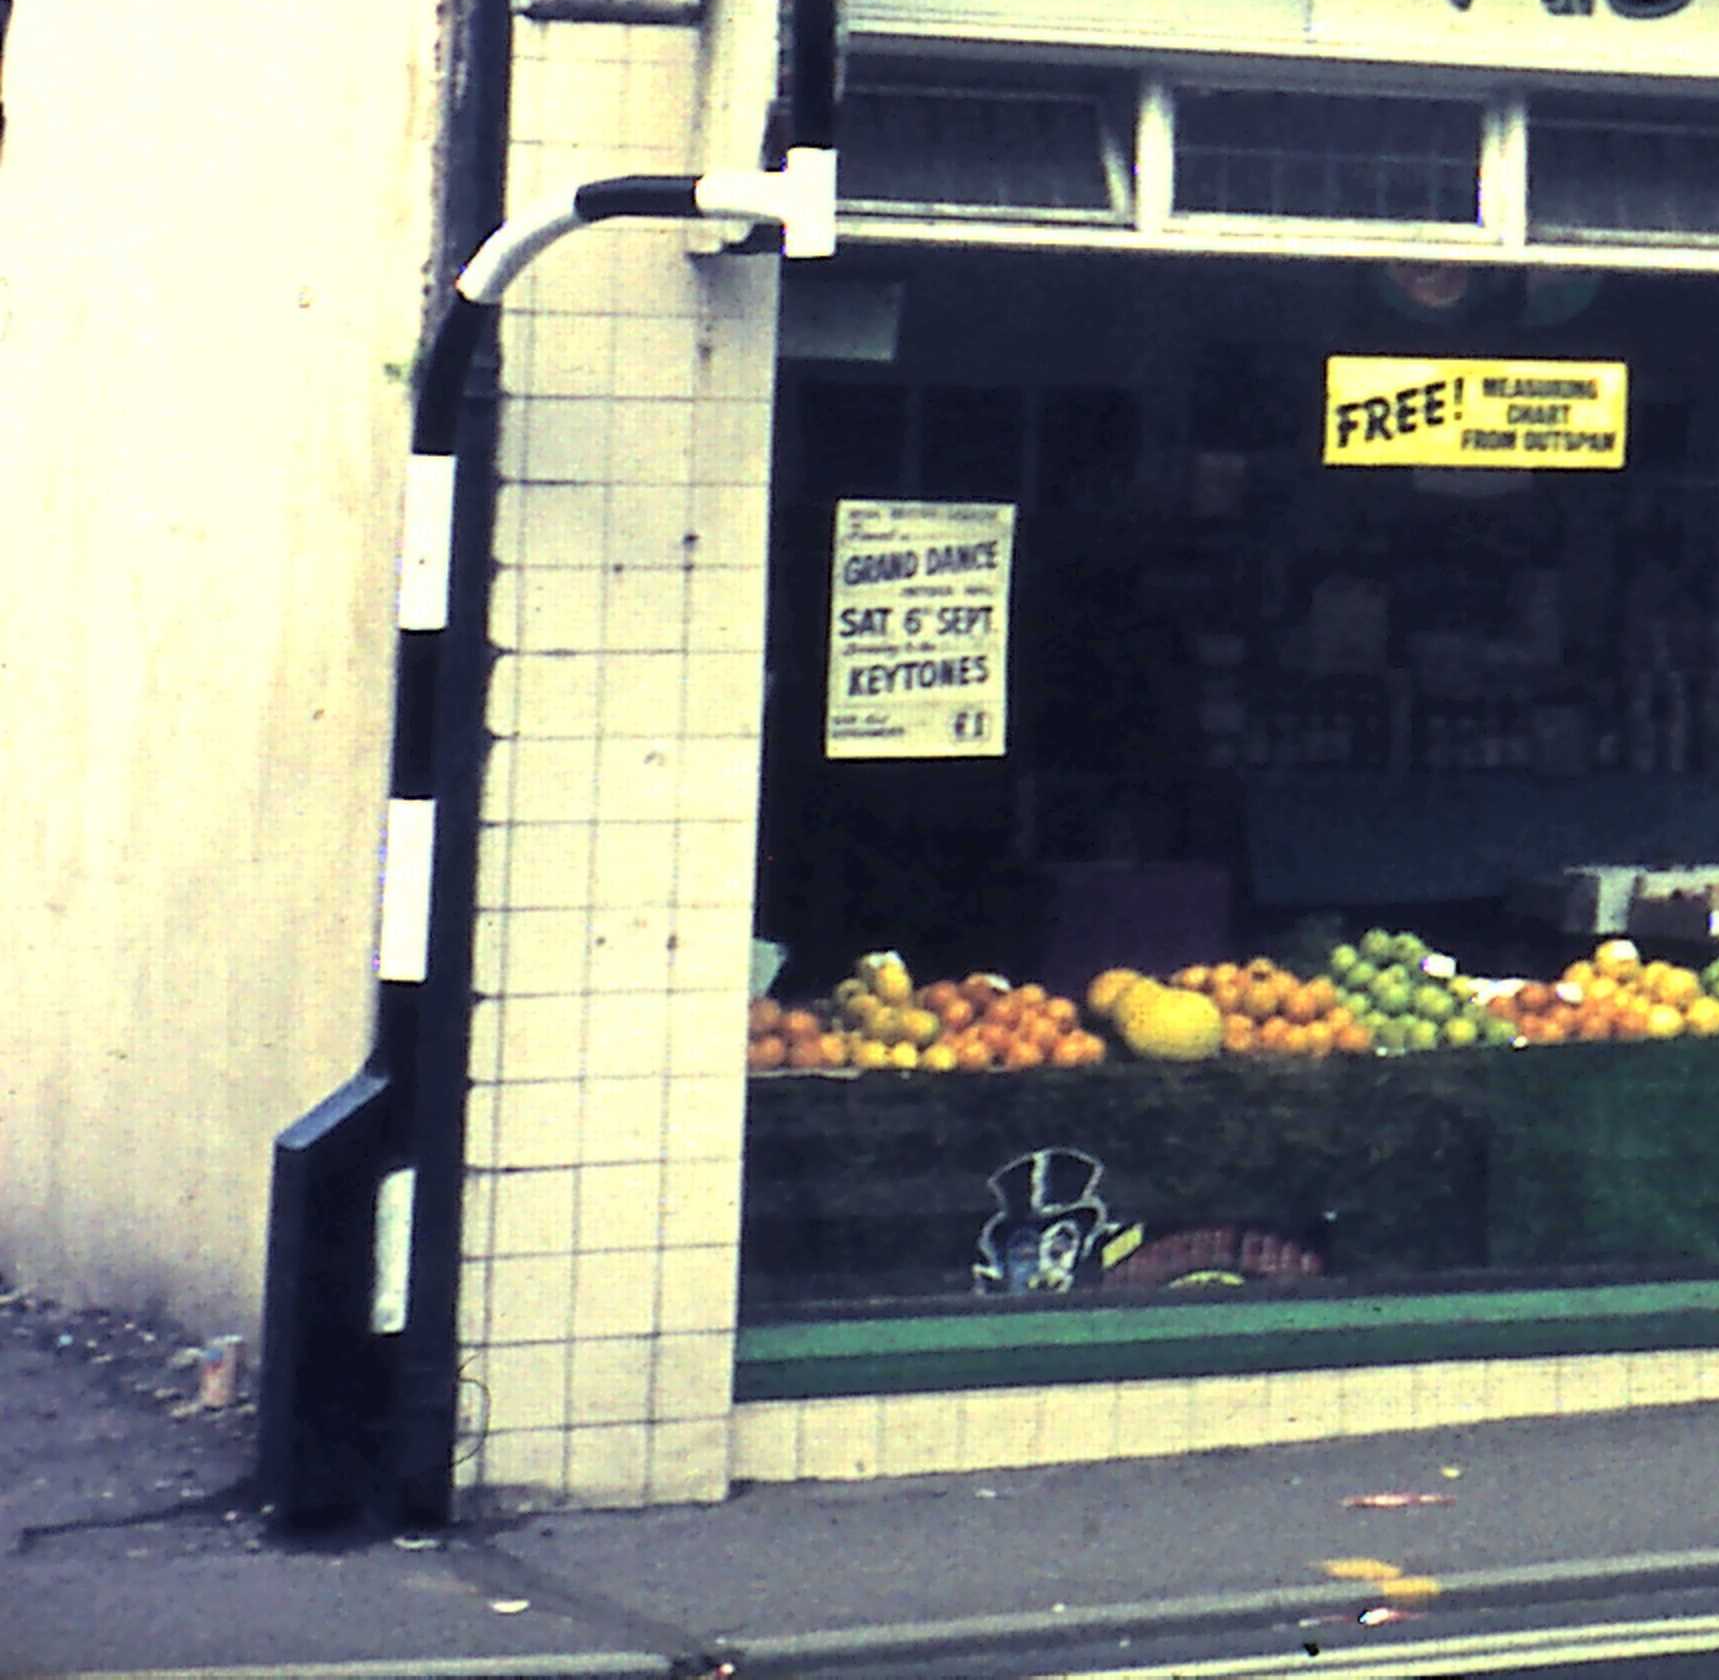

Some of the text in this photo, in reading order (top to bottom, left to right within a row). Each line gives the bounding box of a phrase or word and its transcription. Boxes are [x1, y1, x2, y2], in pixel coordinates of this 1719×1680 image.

[1482, 377, 1598, 400] MEASURING
[1335, 376, 1465, 449] FREE!
[1506, 403, 1572, 426] CHART
[1460, 429, 1617, 453] FROM OUTSPAN
[842, 540, 998, 587] GRAND DANCE
[839, 606, 891, 638] SAT
[847, 654, 989, 697] KEYTONES
